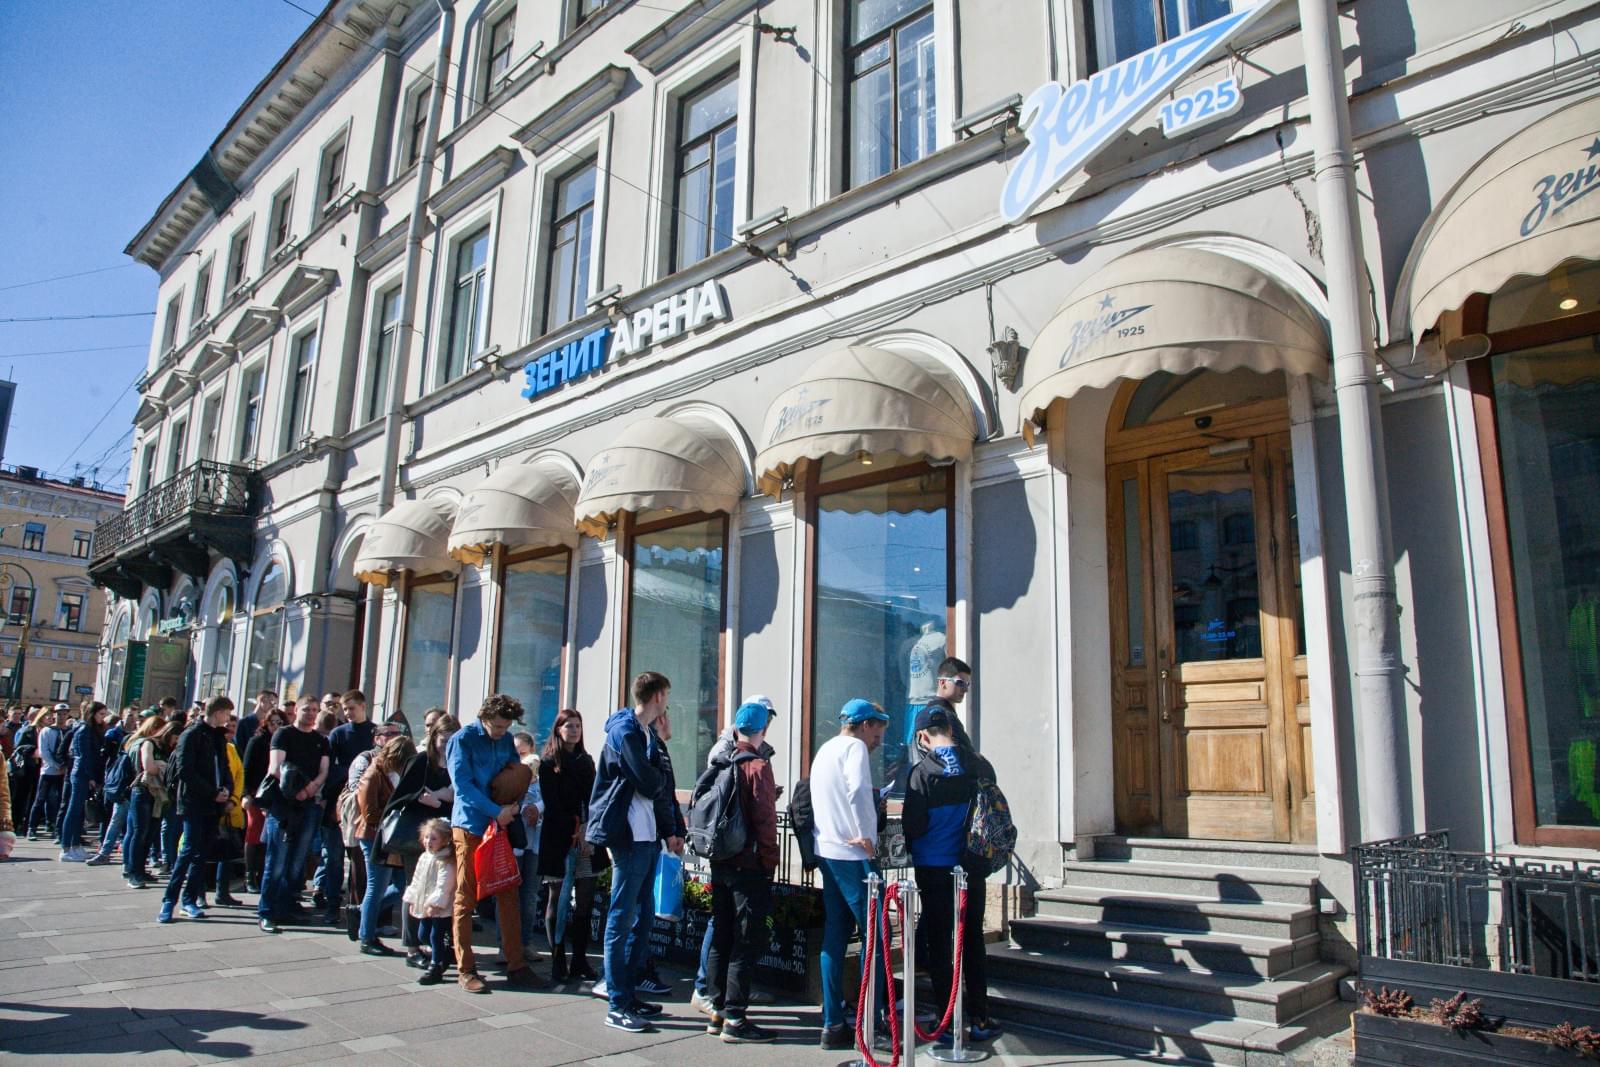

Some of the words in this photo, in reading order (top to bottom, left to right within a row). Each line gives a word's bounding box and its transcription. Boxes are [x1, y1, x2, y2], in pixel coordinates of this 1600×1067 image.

[1161, 79, 1236, 130] 1925
[1520, 164, 1600, 237] Зен
[521, 327, 610, 398] ЗЕНИТ
[607, 278, 727, 364] АРЕНА
[1117, 325, 1145, 339] 1925
